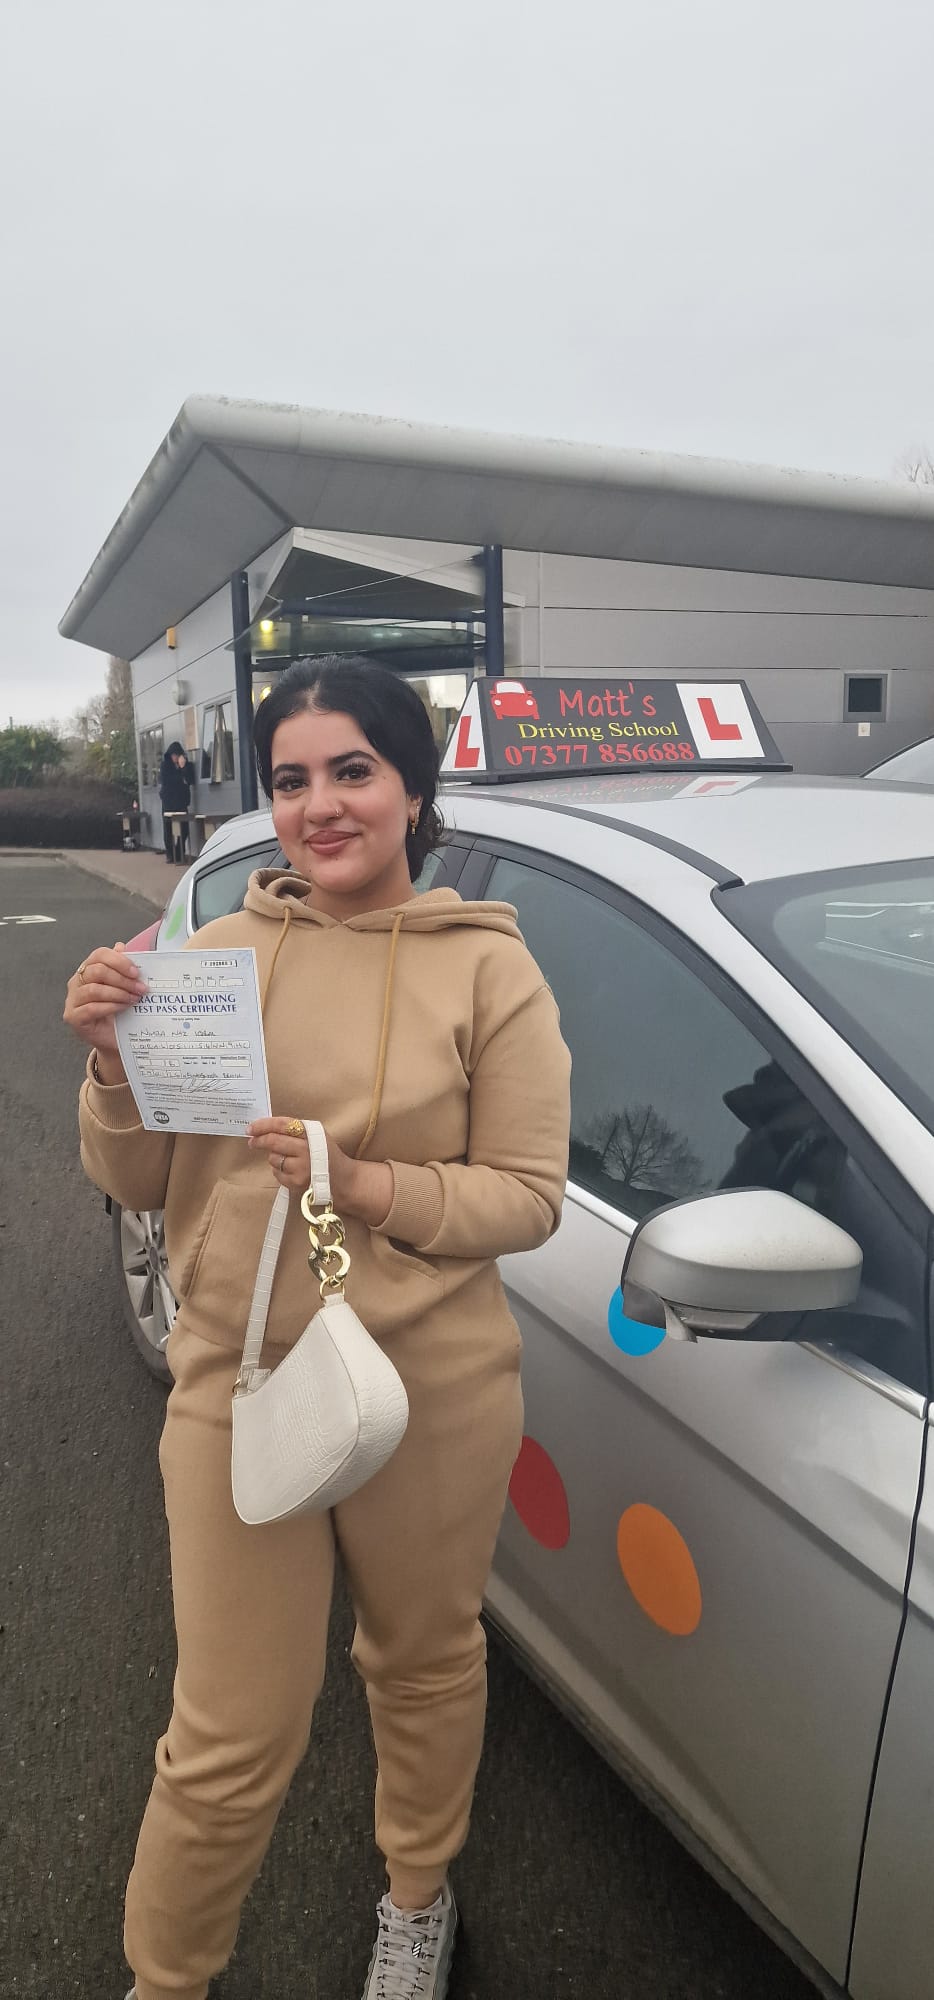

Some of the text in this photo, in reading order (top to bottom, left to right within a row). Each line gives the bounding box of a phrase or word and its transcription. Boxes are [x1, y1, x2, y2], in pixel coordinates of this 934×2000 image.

[559, 681, 657, 718] Matt's
[517, 721, 680, 741] Driving School
[697, 697, 743, 741] L
[454, 715, 481, 769] L
[504, 742, 695, 766] 07377 856688
[133, 1004, 237, 1013] TEST PASS CERTIFICATE
[137, 993, 236, 1004] RACTICAL DRIVING
